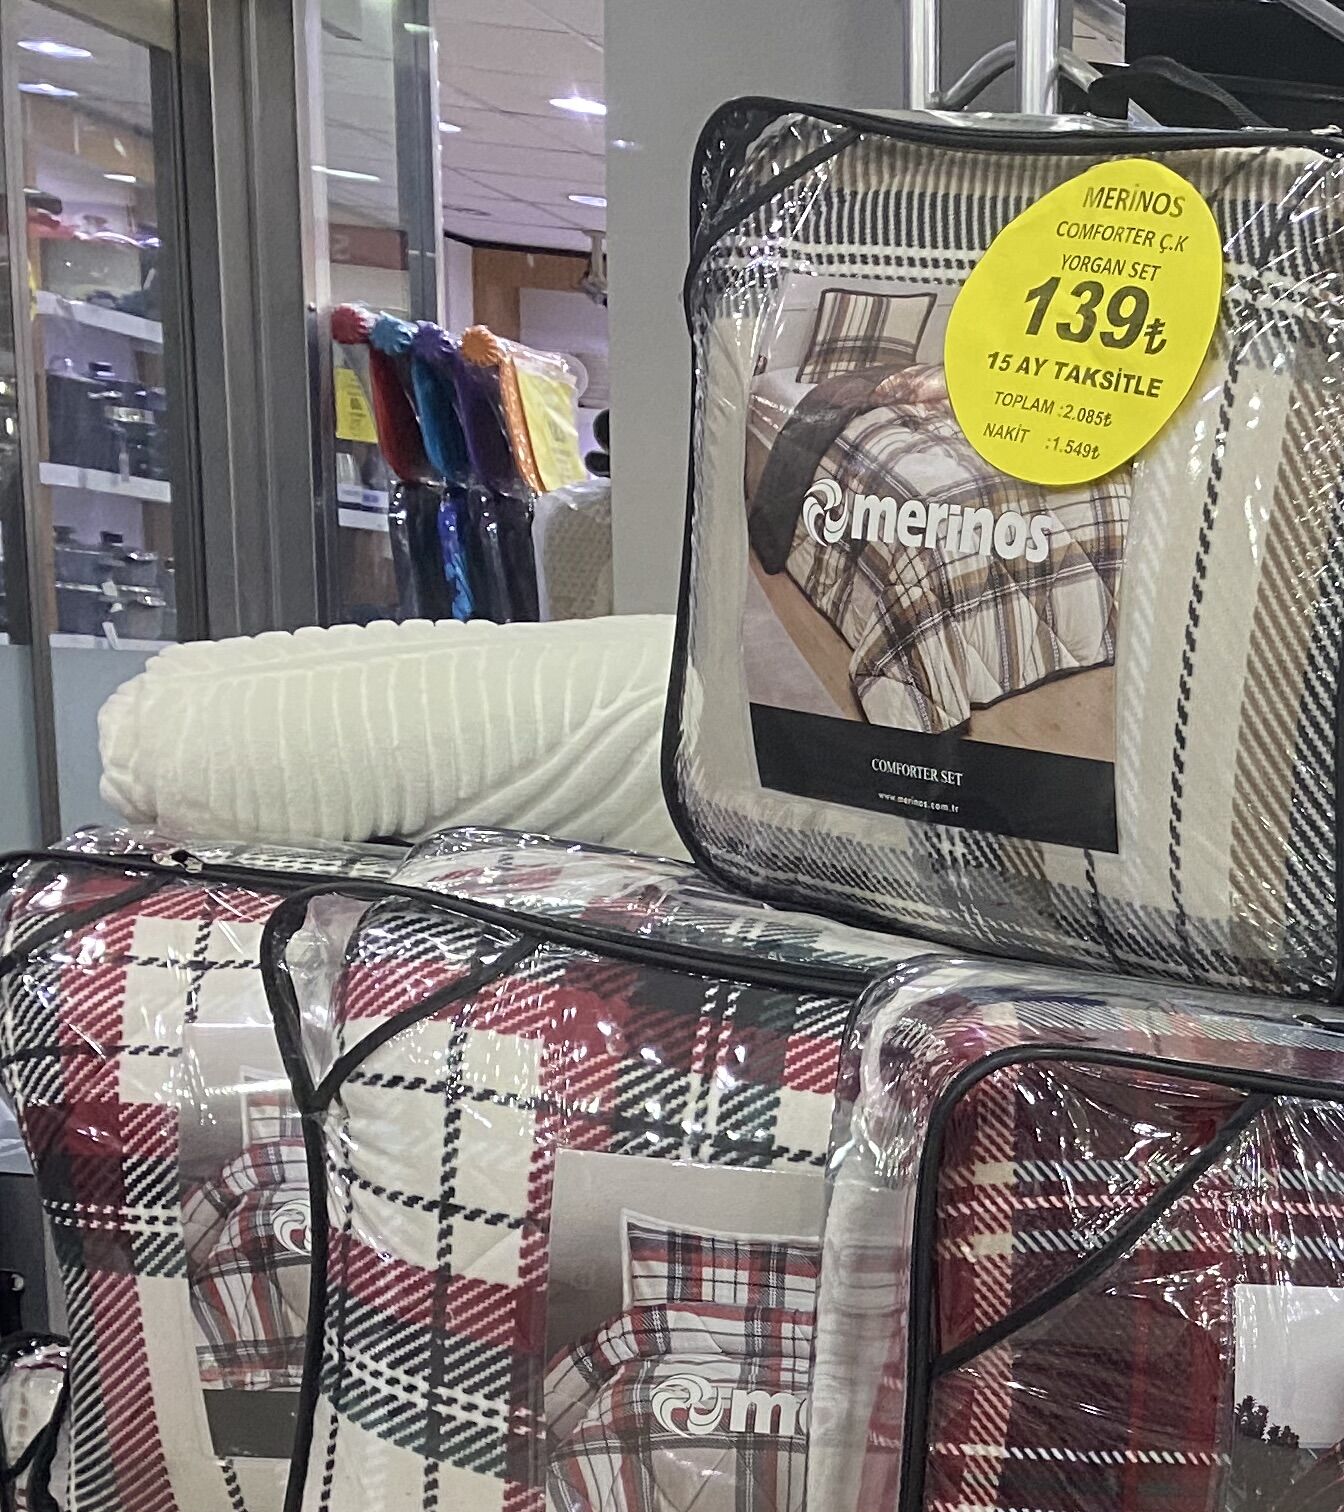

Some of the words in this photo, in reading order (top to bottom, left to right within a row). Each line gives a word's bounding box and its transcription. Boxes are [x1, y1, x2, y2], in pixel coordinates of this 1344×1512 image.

[1082, 183, 1187, 218] MERİNOS
[1056, 220, 1155, 247] COMFORTER
[1158, 234, 1189, 254] Ç.K
[1061, 254, 1126, 276] YORGAN
[1128, 261, 1161, 282] SET
[987, 351, 1011, 372] 15
[1015, 356, 1048, 377] AY
[1054, 361, 1163, 398] TAKSİTLE
[994, 391, 1055, 414] TOPLAM
[983, 422, 1030, 444] NAKİT
[850, 493, 1057, 563] merinos
[871, 757, 938, 783] COMFORTER
[940, 770, 963, 786] SET
[878, 791, 960, 813] www.merinos.com.tr
